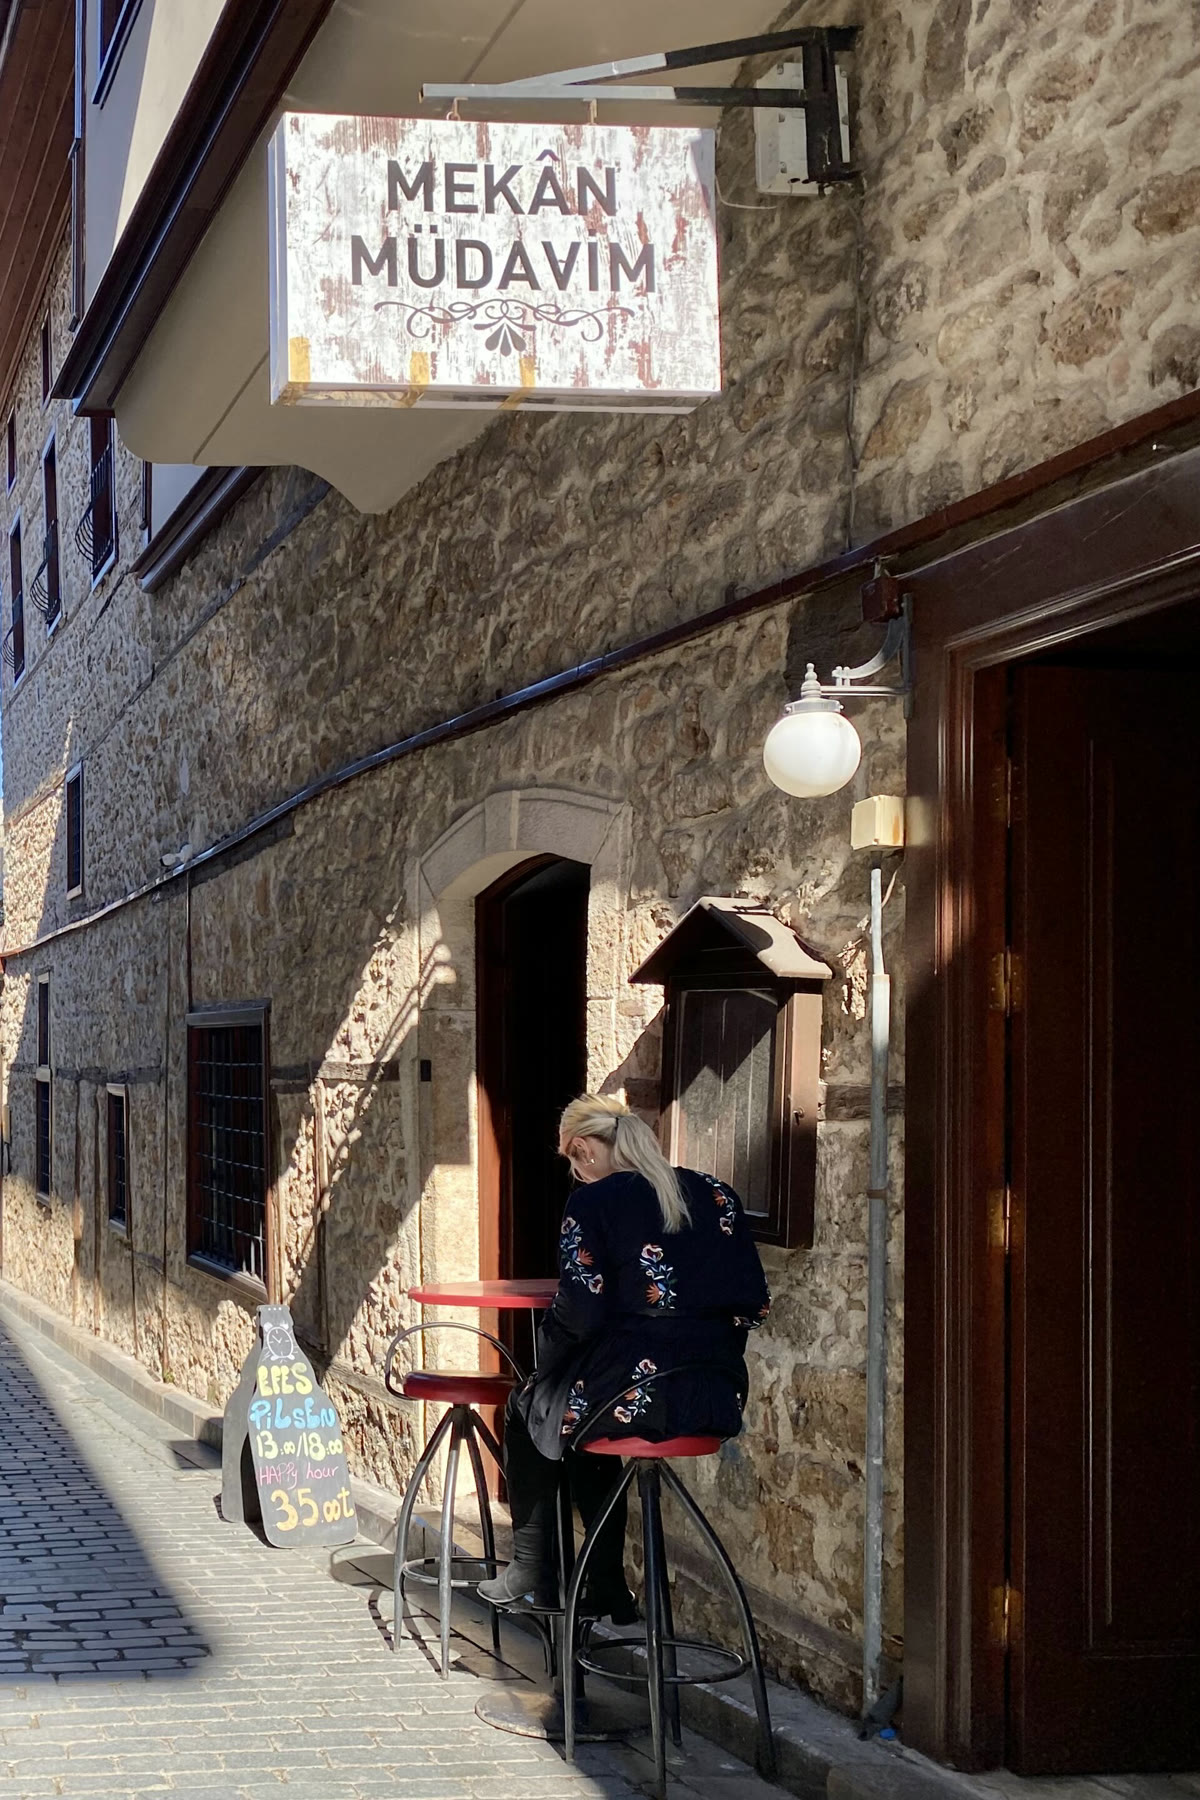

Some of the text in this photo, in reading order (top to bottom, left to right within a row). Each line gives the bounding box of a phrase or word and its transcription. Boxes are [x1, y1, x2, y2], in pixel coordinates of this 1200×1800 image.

[387, 149, 617, 216] MEKÂN
[350, 224, 655, 293] MÜDAVİM
[257, 1362, 313, 1396] EFES
[306, 1462, 339, 1479] hour
